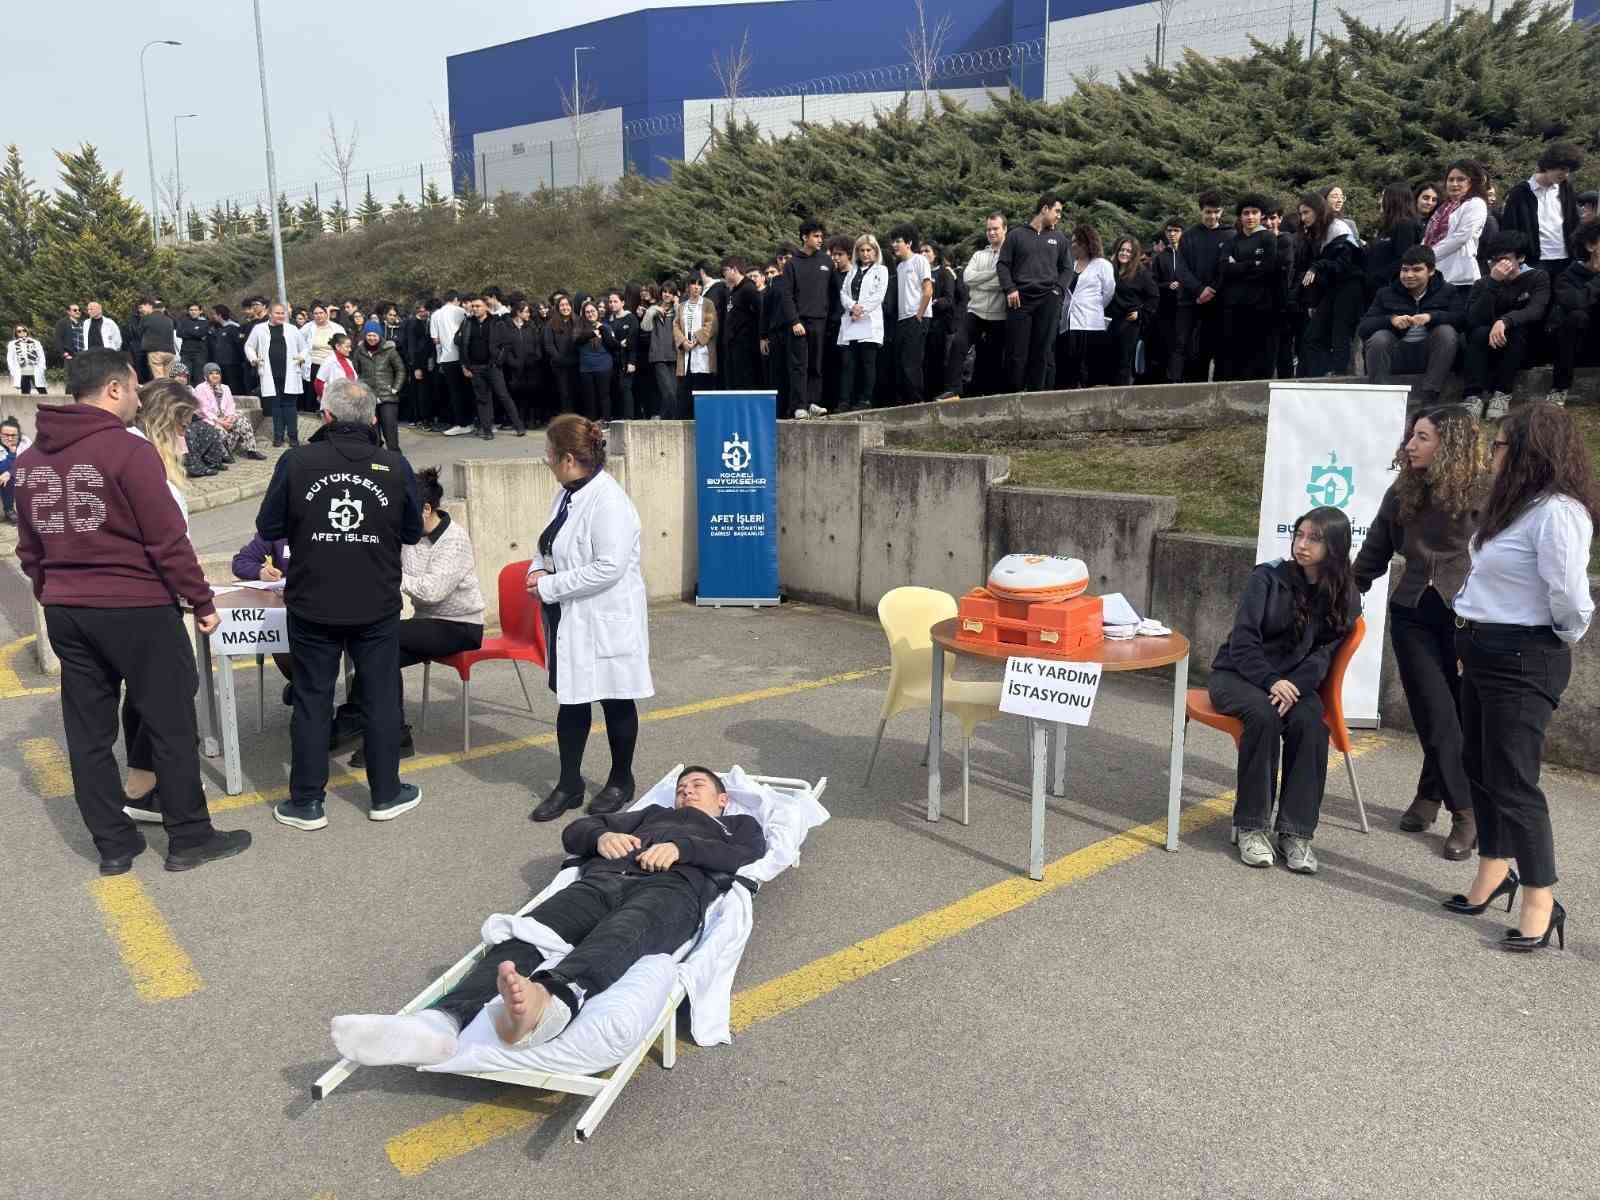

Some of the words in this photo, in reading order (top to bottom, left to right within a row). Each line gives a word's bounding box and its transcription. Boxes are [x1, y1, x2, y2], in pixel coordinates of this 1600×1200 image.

[710, 514, 734, 523] AFET
[736, 512, 764, 524] İŞLERİ
[311, 532, 341, 541] AFET
[222, 629, 280, 644] MASASI
[1011, 660, 1033, 674] İLK
[1037, 663, 1098, 686] YARDIM
[1008, 679, 1092, 708] İSTASYONU
